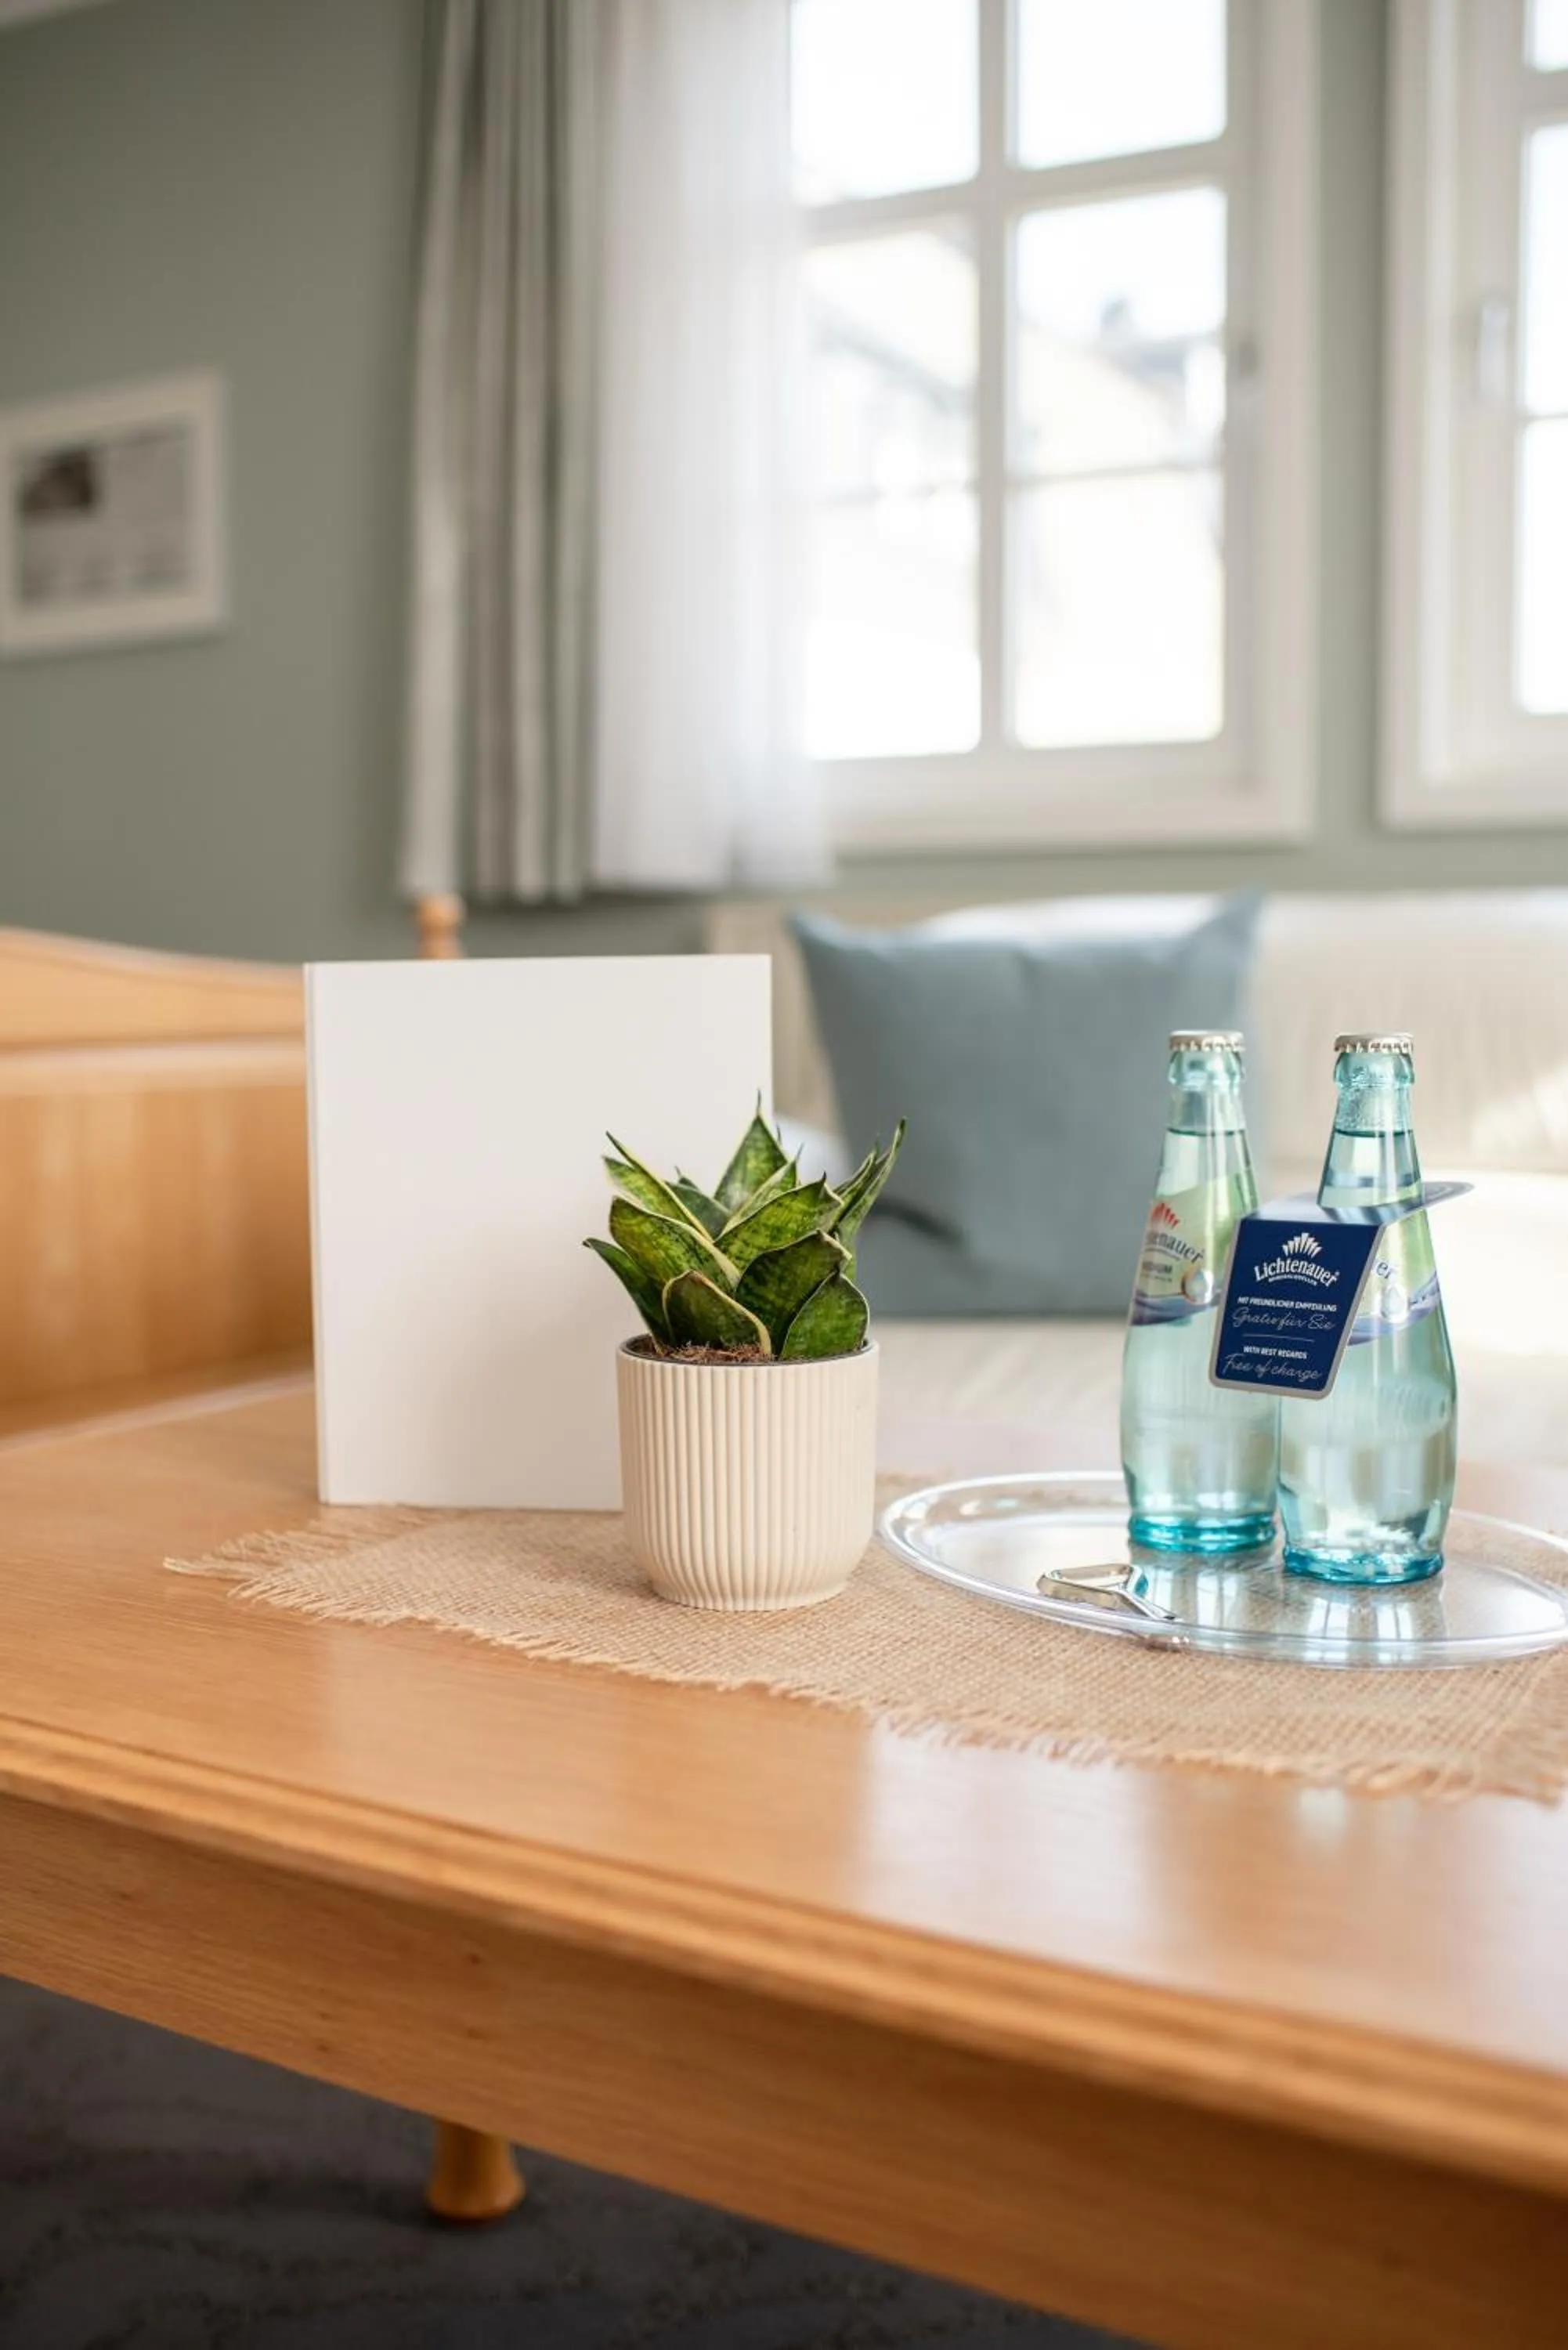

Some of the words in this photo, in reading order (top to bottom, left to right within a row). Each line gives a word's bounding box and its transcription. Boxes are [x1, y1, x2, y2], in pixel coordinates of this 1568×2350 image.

[1254, 1256, 1338, 1287] Lichtenauer
[1237, 1296, 1249, 1304] MIT
[1243, 1345, 1260, 1354] WITH
[1260, 1347, 1277, 1356] BEST
[1277, 1349, 1308, 1359] REGARDS
[1223, 1353, 1253, 1375] Free
[1270, 1361, 1322, 1383] charge
